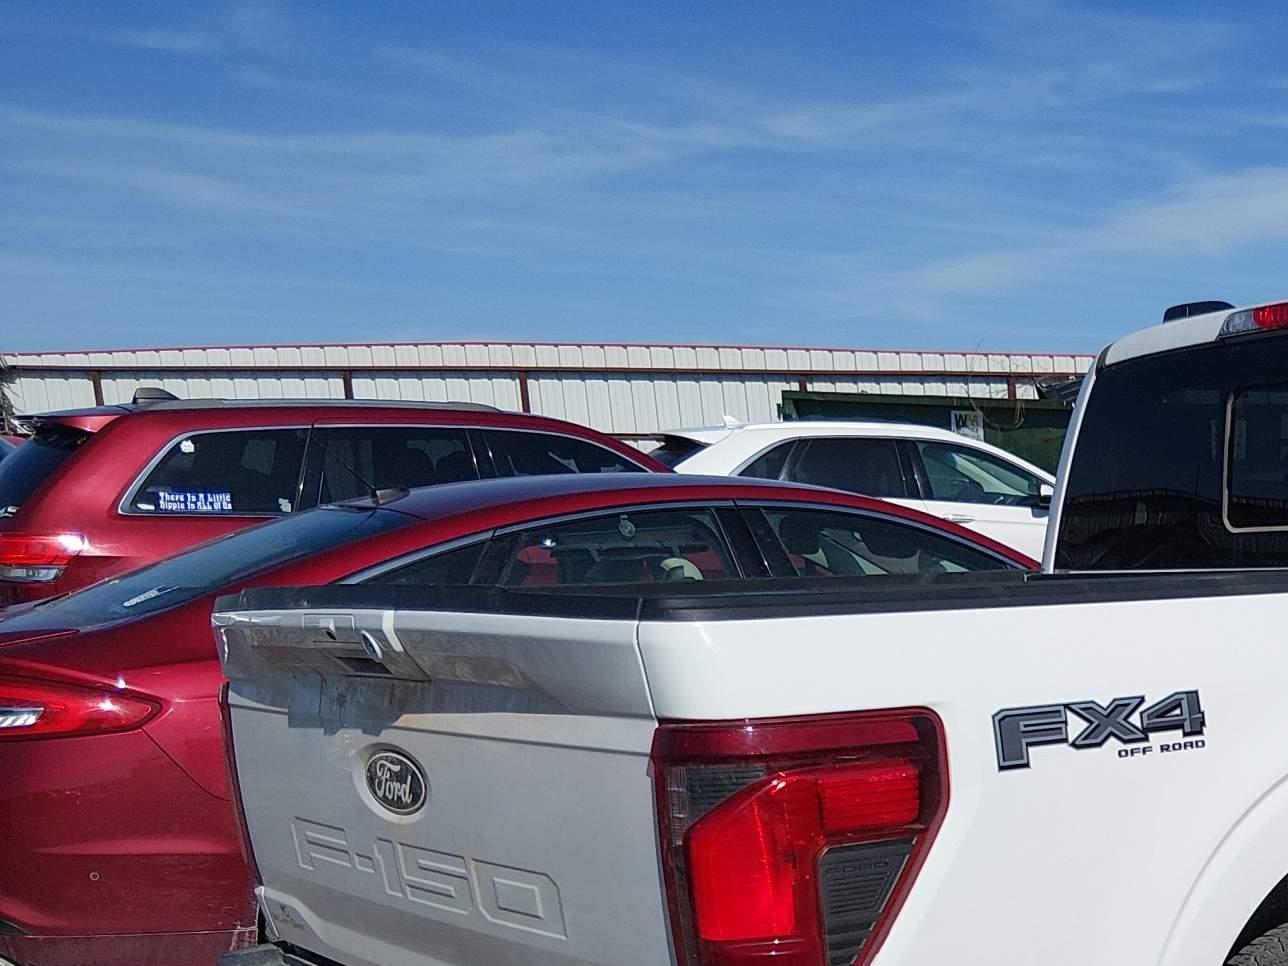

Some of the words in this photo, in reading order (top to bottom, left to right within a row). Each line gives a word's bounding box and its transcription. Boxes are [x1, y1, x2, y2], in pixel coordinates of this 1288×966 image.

[159, 492, 185, 501] There
[208, 493, 231, 502] Little
[991, 689, 1206, 772] FX4
[1117, 745, 1153, 758] OFF
[1159, 739, 1206, 753] ROAD
[375, 760, 413, 804] Ford
[291, 816, 568, 941] F-150
